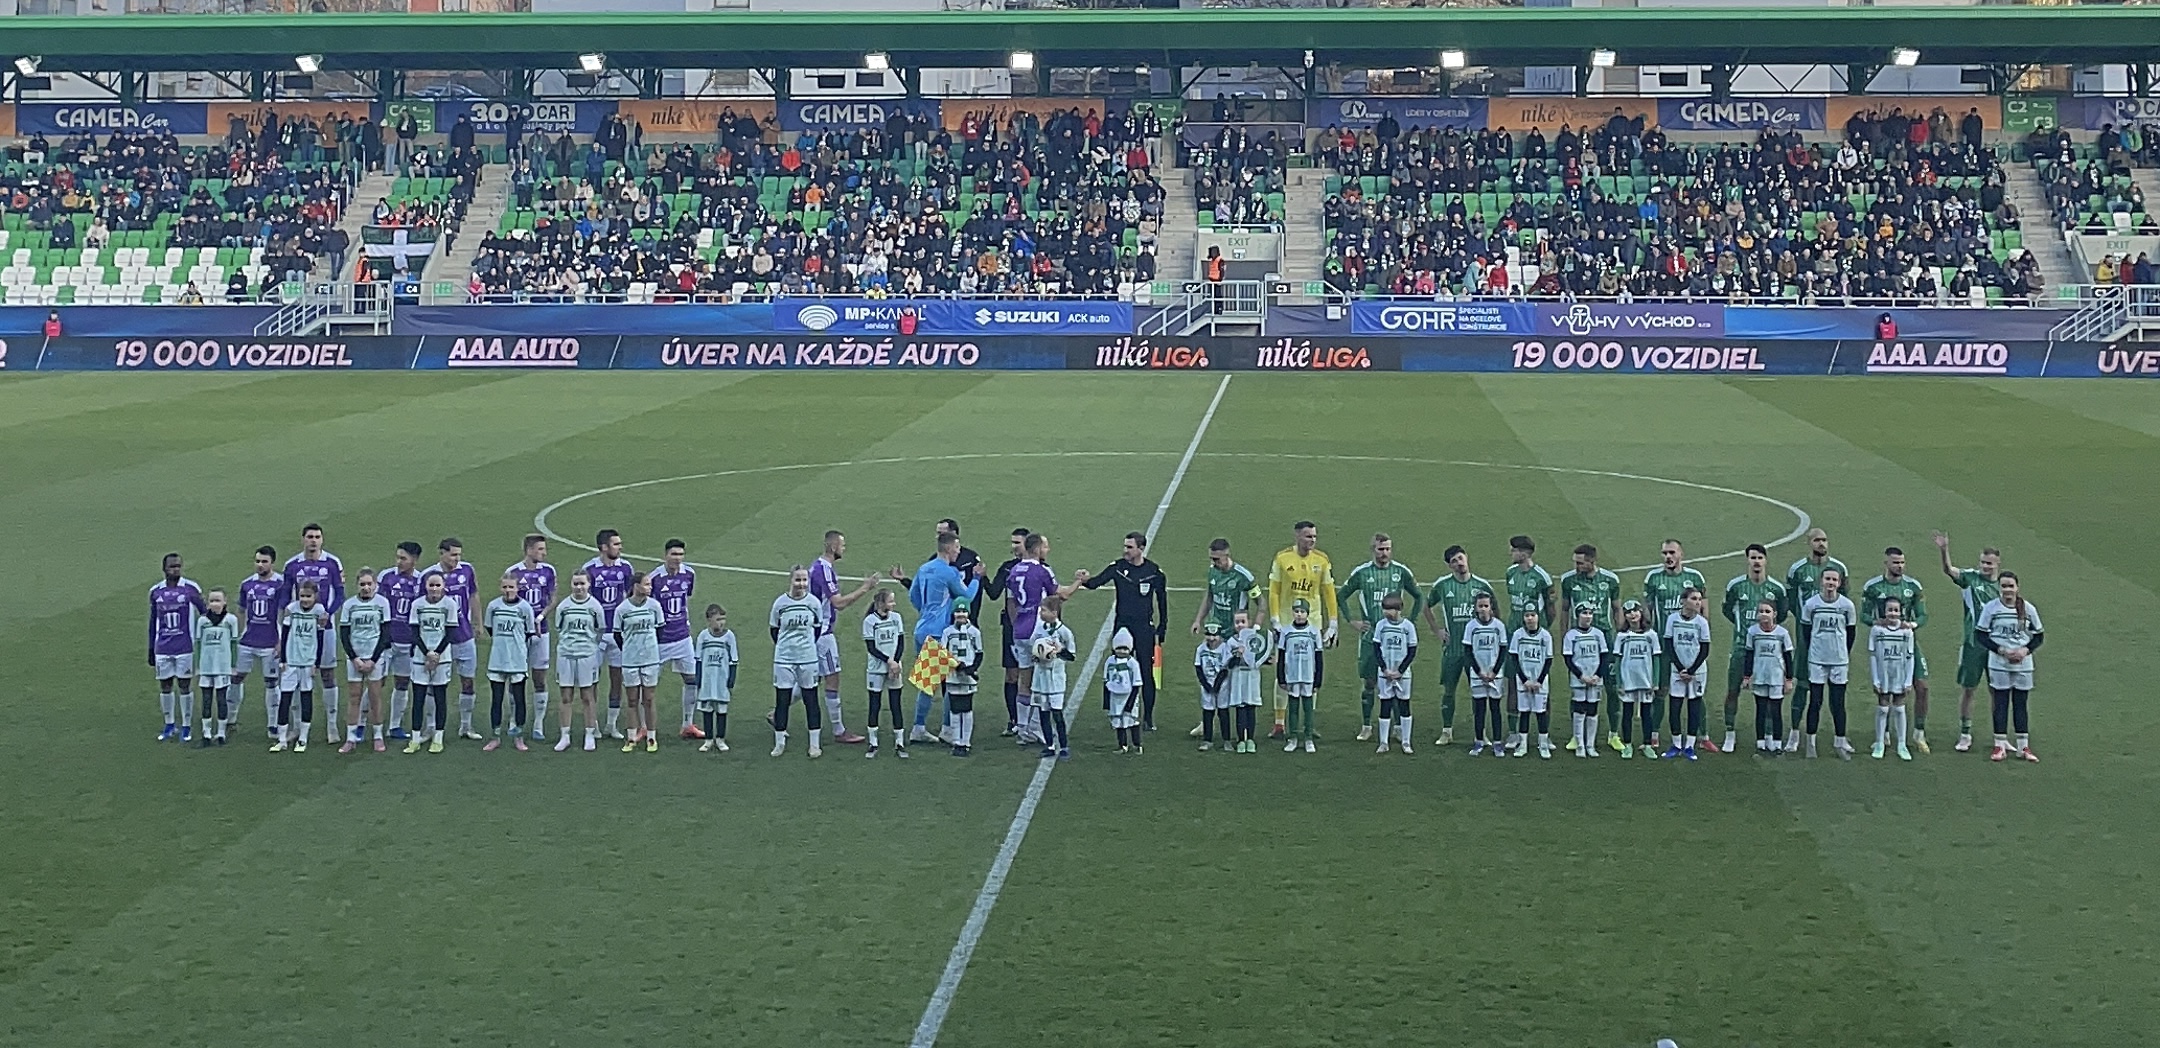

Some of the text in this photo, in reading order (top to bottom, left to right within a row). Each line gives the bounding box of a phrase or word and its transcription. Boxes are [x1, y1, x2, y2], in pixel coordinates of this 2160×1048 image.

[470, 103, 509, 122] 30
[800, 104, 885, 124] CAMEA
[1680, 103, 1801, 123] CAMEA Car
[2007, 101, 2028, 112] C2
[54, 107, 169, 129] CAMEA Car
[2033, 116, 2054, 129] C3
[1228, 238, 1250, 246] EXIT
[2106, 240, 2130, 249] EXIT
[994, 310, 1060, 323] SUZUKI
[1067, 313, 1111, 323] ACK auto
[1380, 306, 1457, 331] GOHR
[1625, 312, 1696, 330] VÝCHOD
[114, 340, 353, 367] 19 000 VOZIDIEL
[448, 337, 580, 361] AAA AUTO
[660, 337, 980, 366] ÚVER NA KAŽDÉ AUTO
[1096, 336, 1209, 368] niké LIGA
[1257, 337, 1371, 369] niké LIGA
[1512, 341, 1766, 371] 19 000 VOZIDIEL
[1866, 342, 2009, 367] AAA AUTO
[1014, 576, 1027, 605] 3
